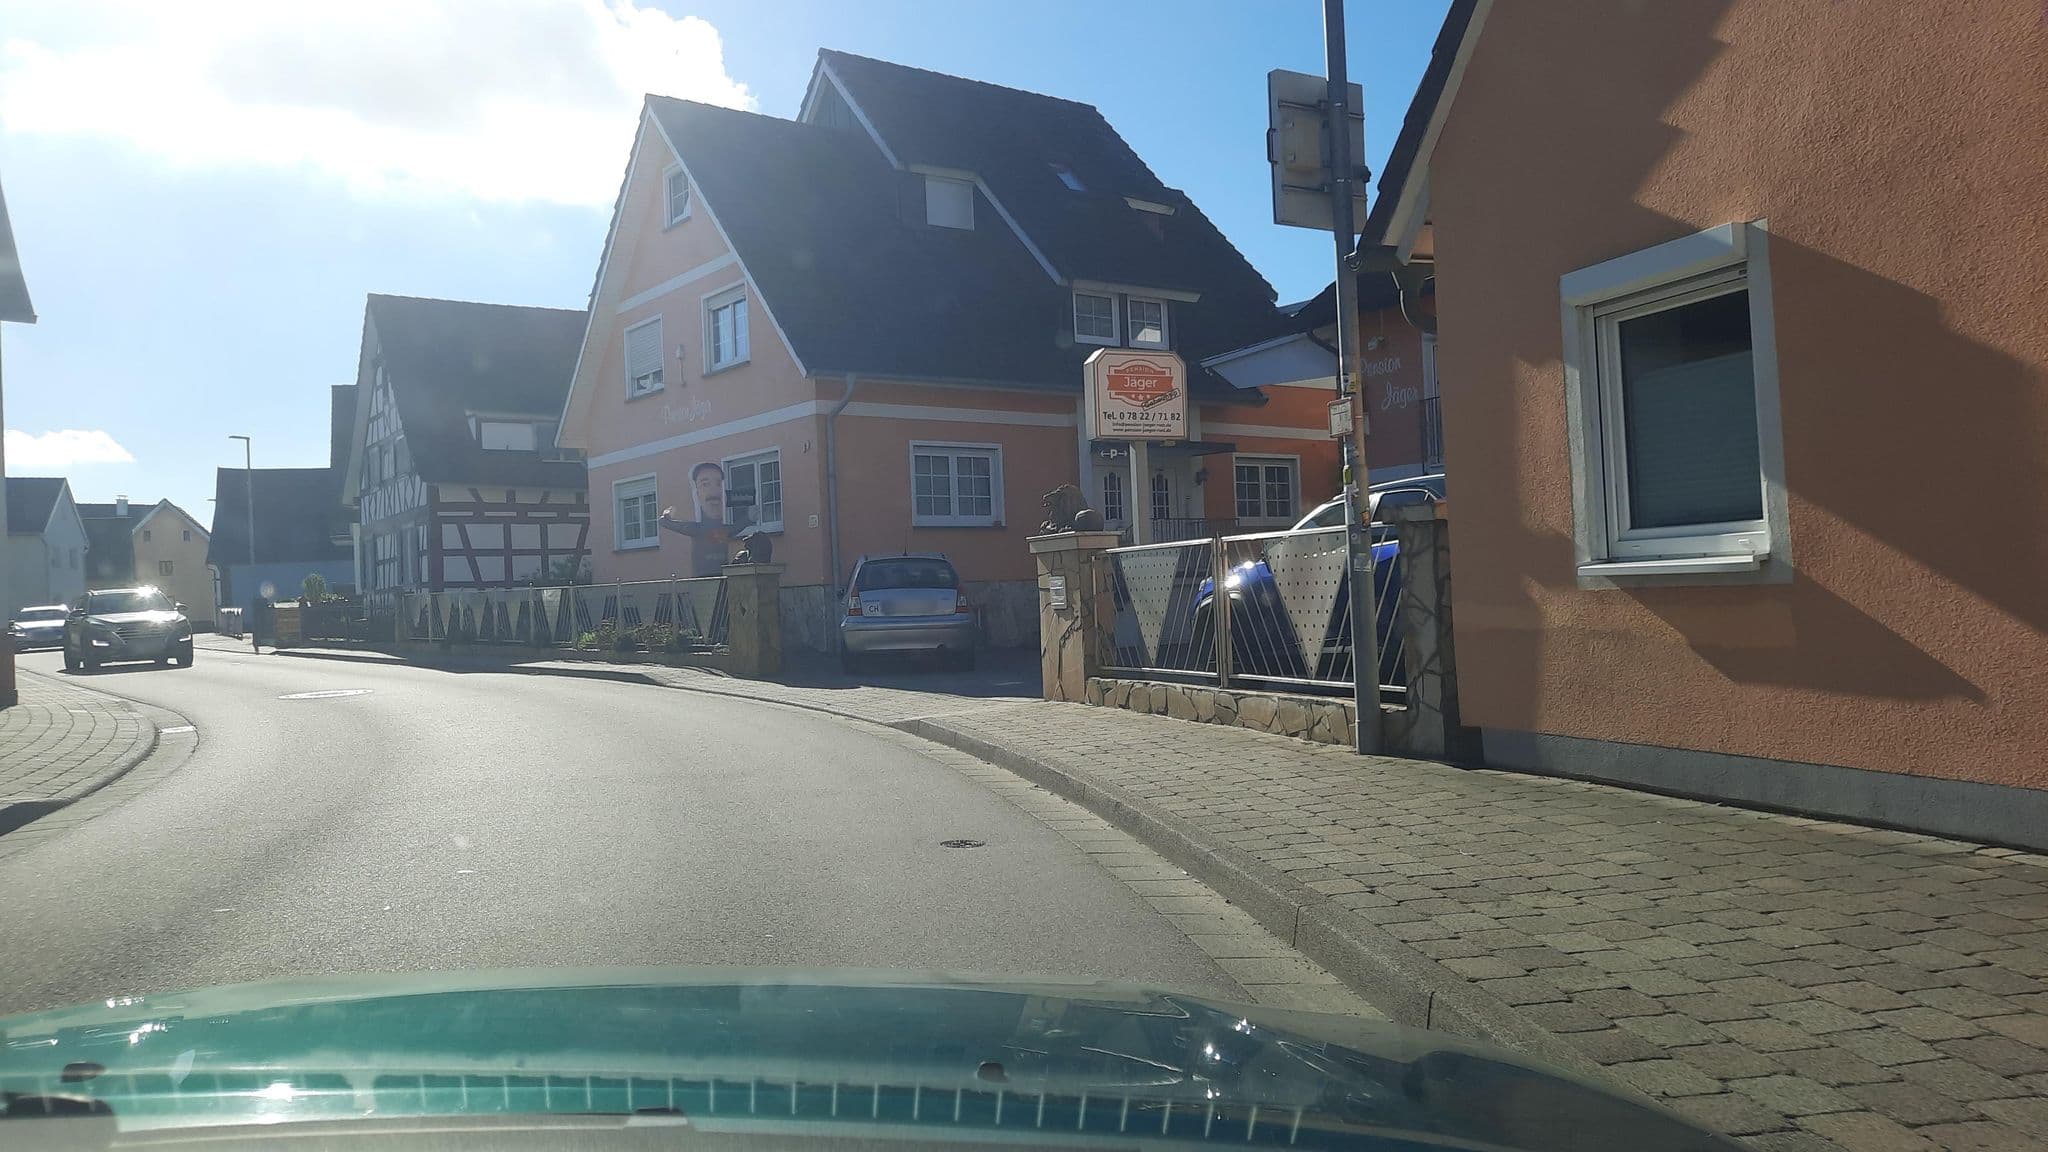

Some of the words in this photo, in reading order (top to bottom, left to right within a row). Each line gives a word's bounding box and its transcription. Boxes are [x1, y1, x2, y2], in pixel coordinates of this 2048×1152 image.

[1123, 376, 1157, 390] Jäger
[1119, 412, 1125, 420] 0
[1127, 412, 1137, 420] 78
[1140, 412, 1150, 420] 22
[1110, 449, 1118, 458] P
